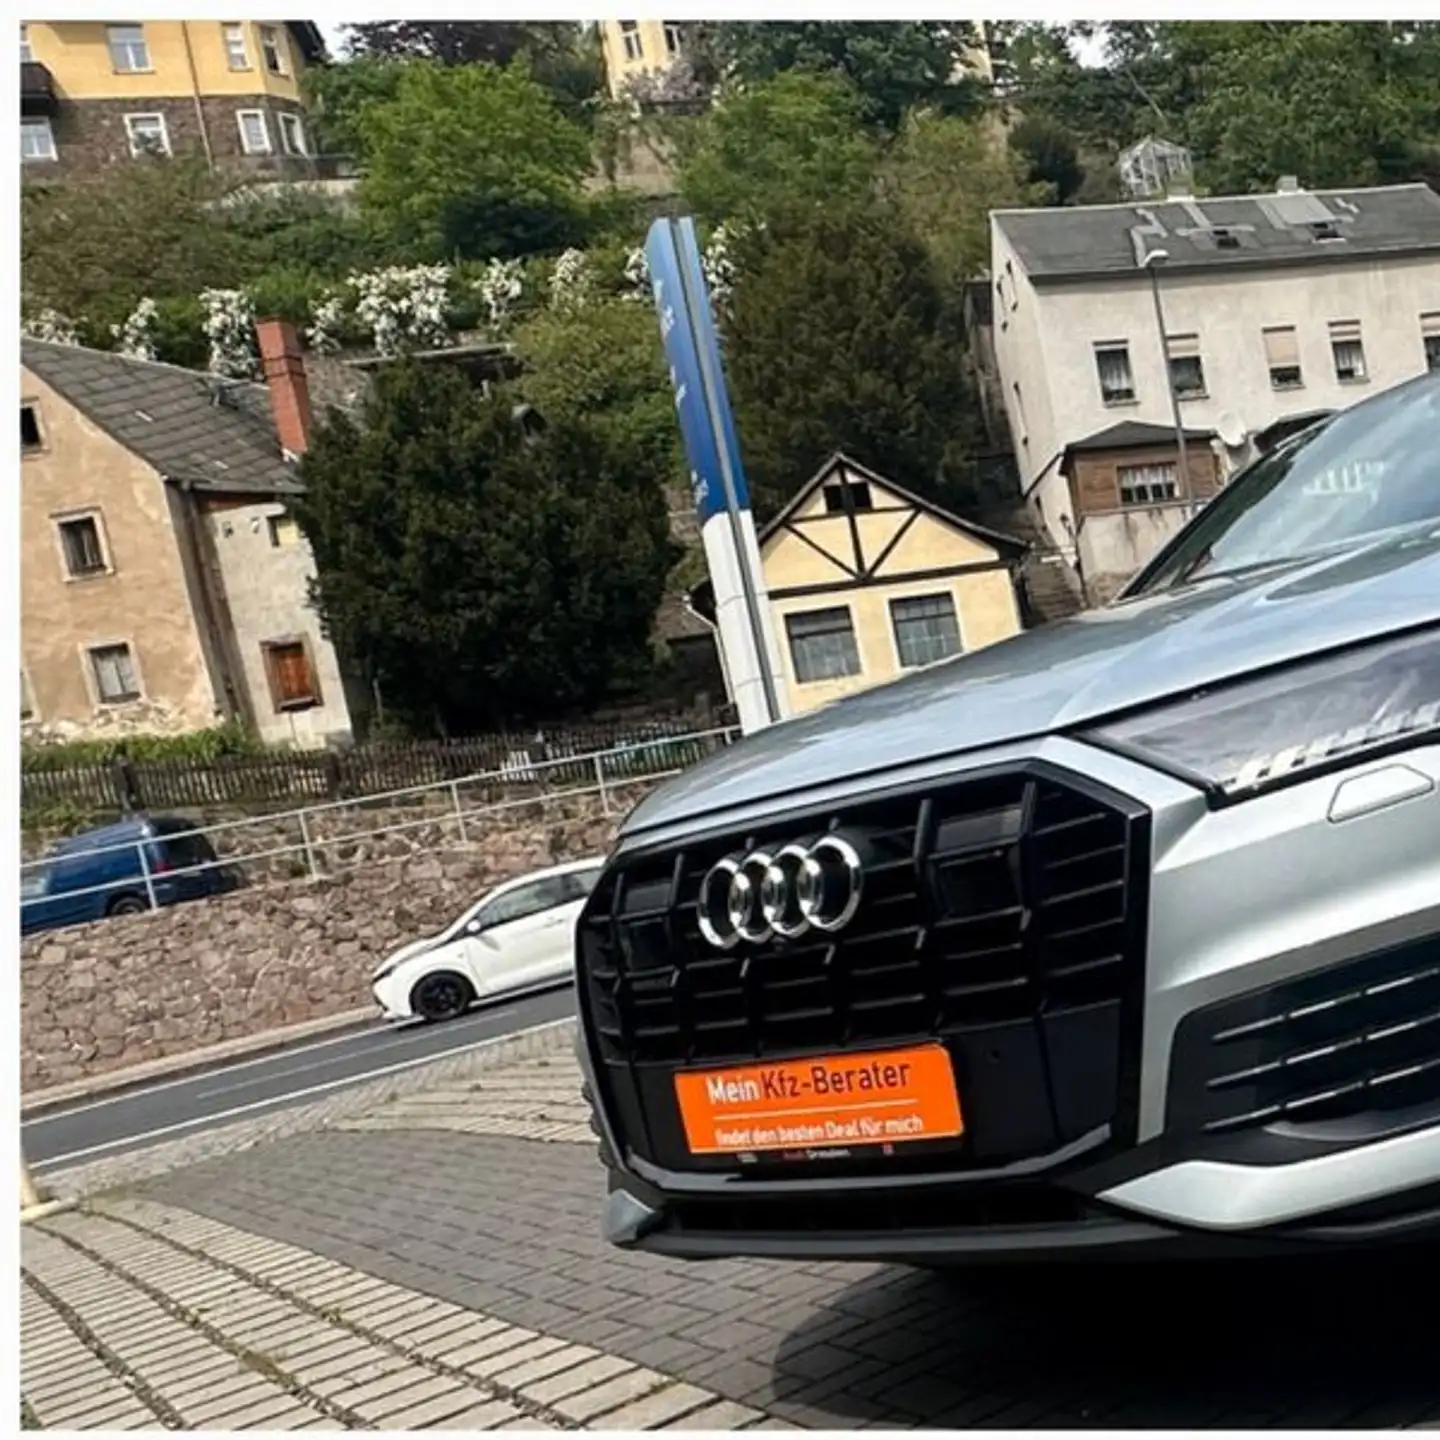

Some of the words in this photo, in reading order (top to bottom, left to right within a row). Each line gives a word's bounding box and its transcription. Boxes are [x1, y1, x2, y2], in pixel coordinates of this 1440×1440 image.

[706, 1076, 760, 1104] Mein
[760, 1061, 911, 1099] Kfz-Berater
[752, 1126, 776, 1144] den
[777, 1122, 825, 1143] besten
[824, 1117, 859, 1138] Deal
[859, 1114, 883, 1136] für
[885, 1112, 923, 1133] mich
